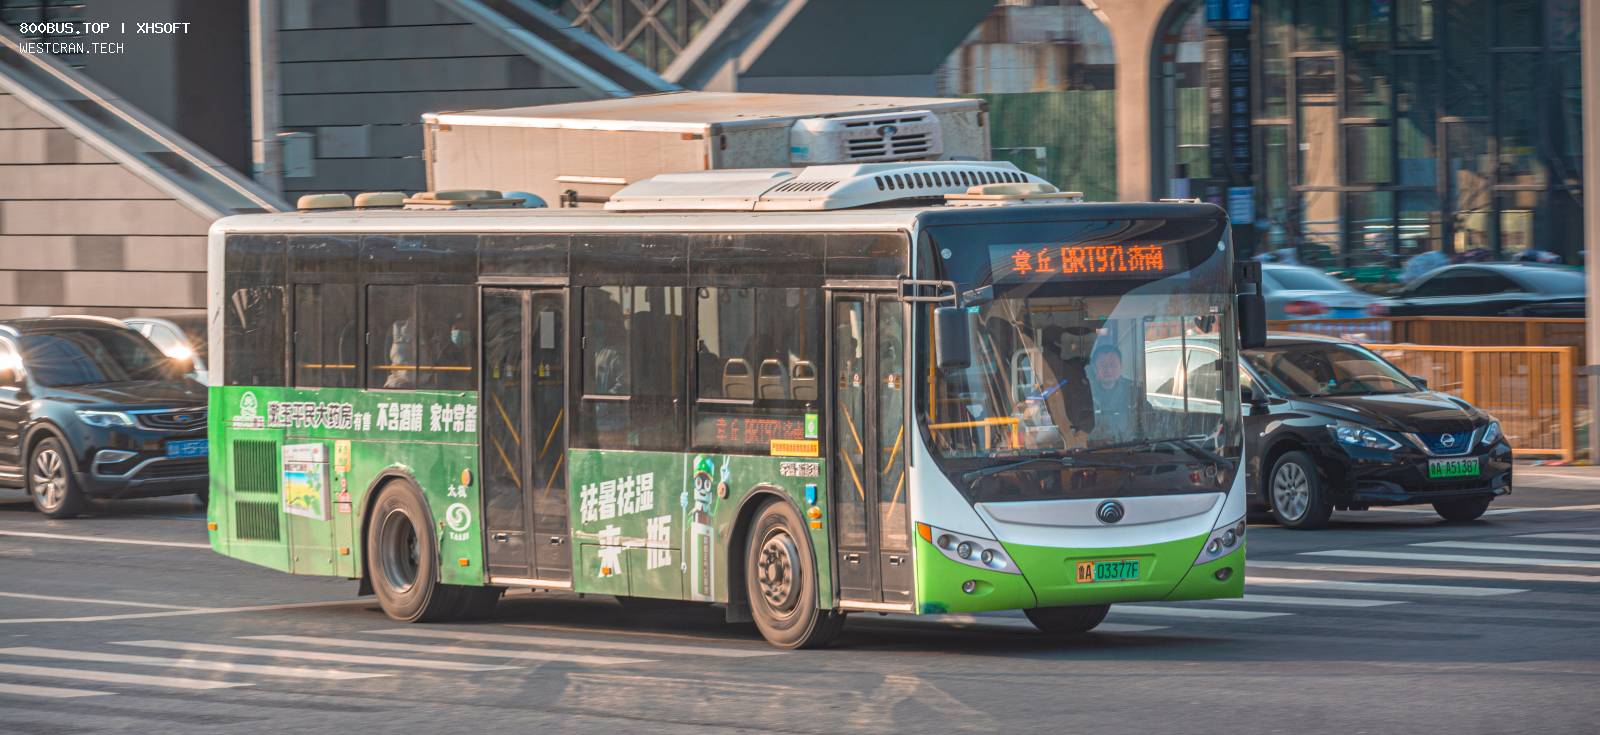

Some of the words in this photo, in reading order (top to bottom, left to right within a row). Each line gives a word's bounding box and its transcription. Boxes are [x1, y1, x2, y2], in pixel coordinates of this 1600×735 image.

[1011, 248, 1056, 275] 章丘
[376, 402, 424, 432] 不含酒精
[429, 403, 478, 432] 家中常备
[580, 472, 654, 525] 祛暑祛湿
[598, 515, 672, 578] 来一瓶
[1097, 561, 1139, 579] 03377F
